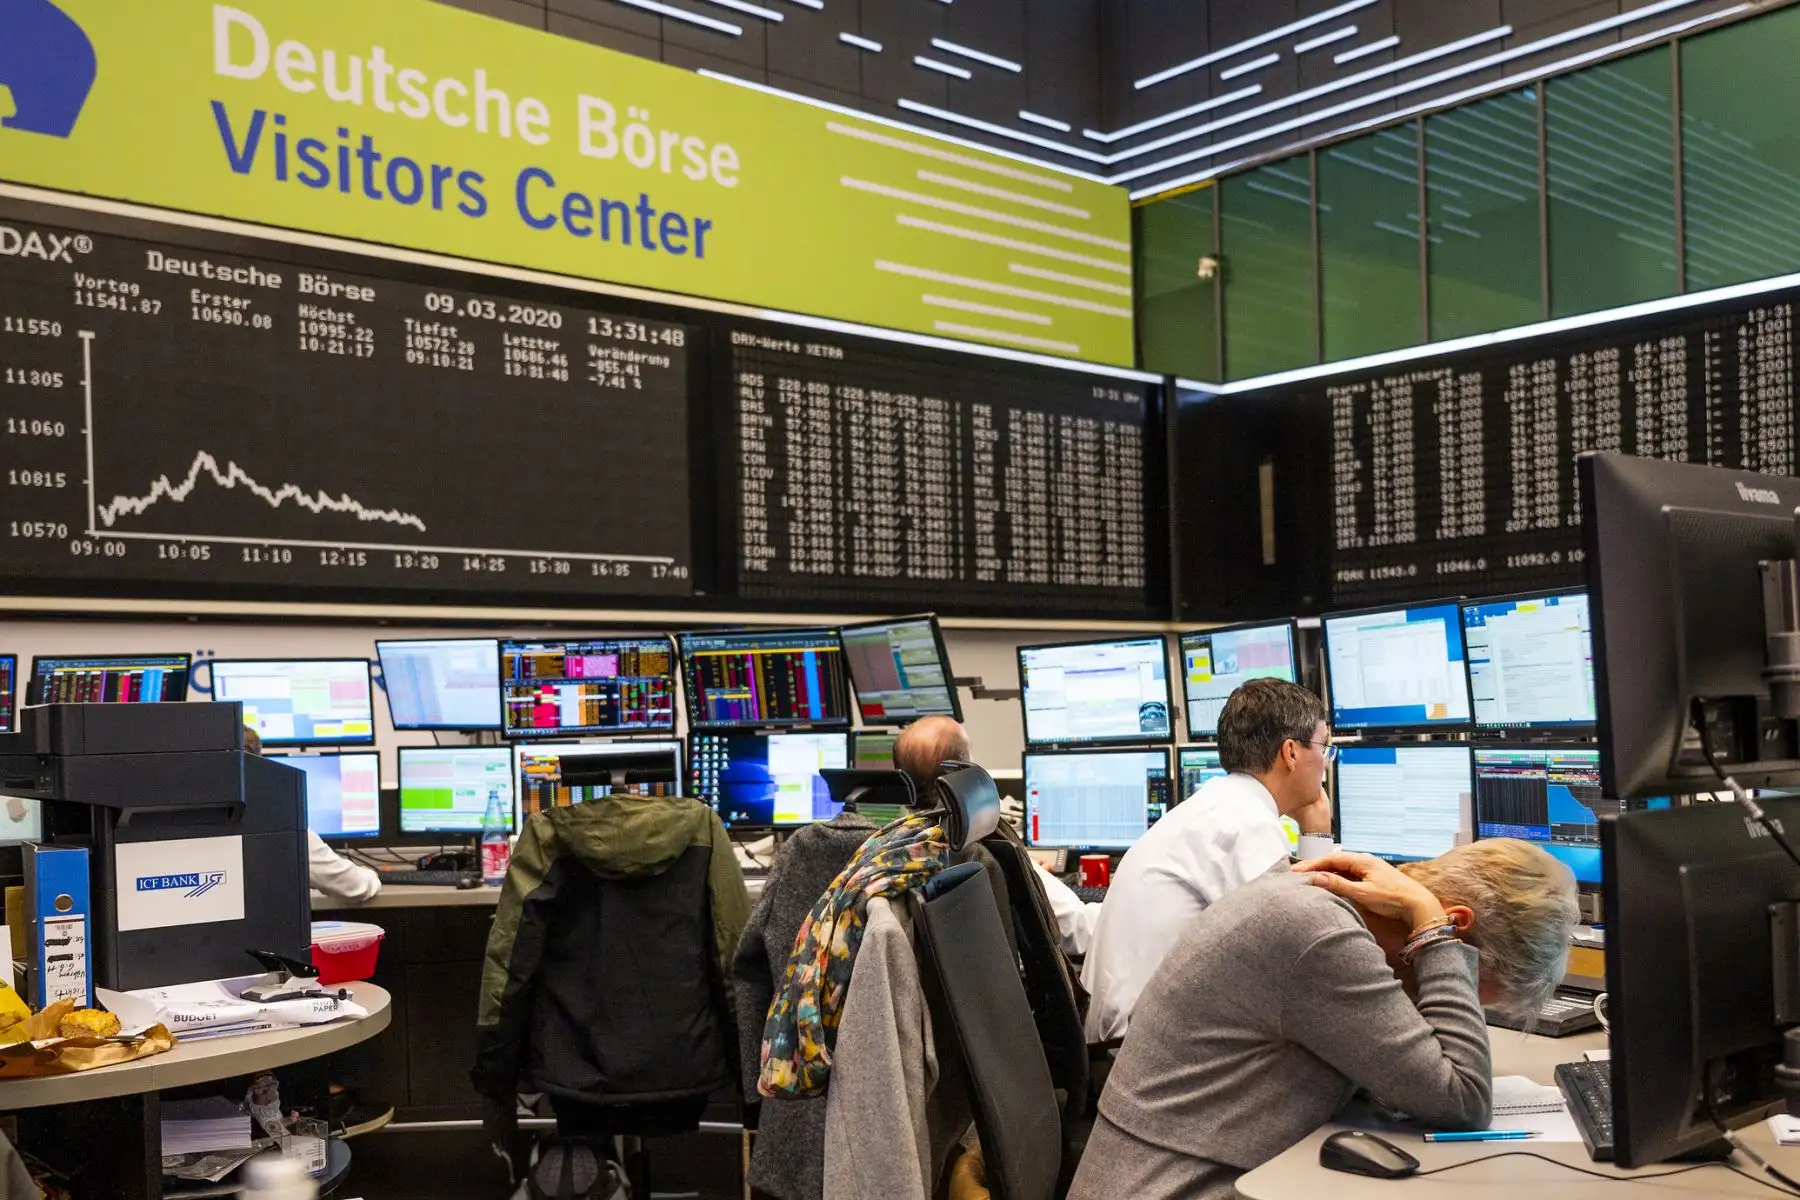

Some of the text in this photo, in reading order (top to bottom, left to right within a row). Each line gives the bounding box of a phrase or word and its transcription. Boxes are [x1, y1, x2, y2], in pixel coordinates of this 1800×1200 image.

[212, 3, 741, 188] Deutsche Börse
[210, 99, 713, 260] Visitors Center
[73, 272, 140, 296] Vortag
[74, 291, 162, 315] 11541.87
[147, 250, 685, 348] Deutsche Börse 09.03.2020 13:31:48
[191, 289, 251, 310] Erster
[191, 306, 272, 330] 10690.08
[298, 304, 355, 325] Höchst
[4, 316, 62, 337] 11550
[298, 320, 374, 343] 10995.22
[404, 318, 458, 338] Tiefst
[299, 336, 375, 358] 10:21:17
[503, 332, 560, 352] Letzter
[730, 331, 844, 360] DAX-Werte XETRA
[406, 349, 474, 371] 09:10:21
[588, 344, 671, 368] Veränderung
[6, 368, 64, 388] 11305
[740, 372, 764, 387] ADS
[740, 386, 764, 400] ALV
[8, 418, 65, 438] 11060
[742, 440, 766, 452] BMW
[8, 470, 66, 489] 10815
[10, 522, 68, 539] 10570
[744, 532, 767, 544] DTE
[70, 540, 688, 580] 09:00 10:05 11:10 12:15 13:20 14:25 15:30 16:35 17:40
[139, 878, 159, 890] ICF
[162, 875, 198, 887] BANK
